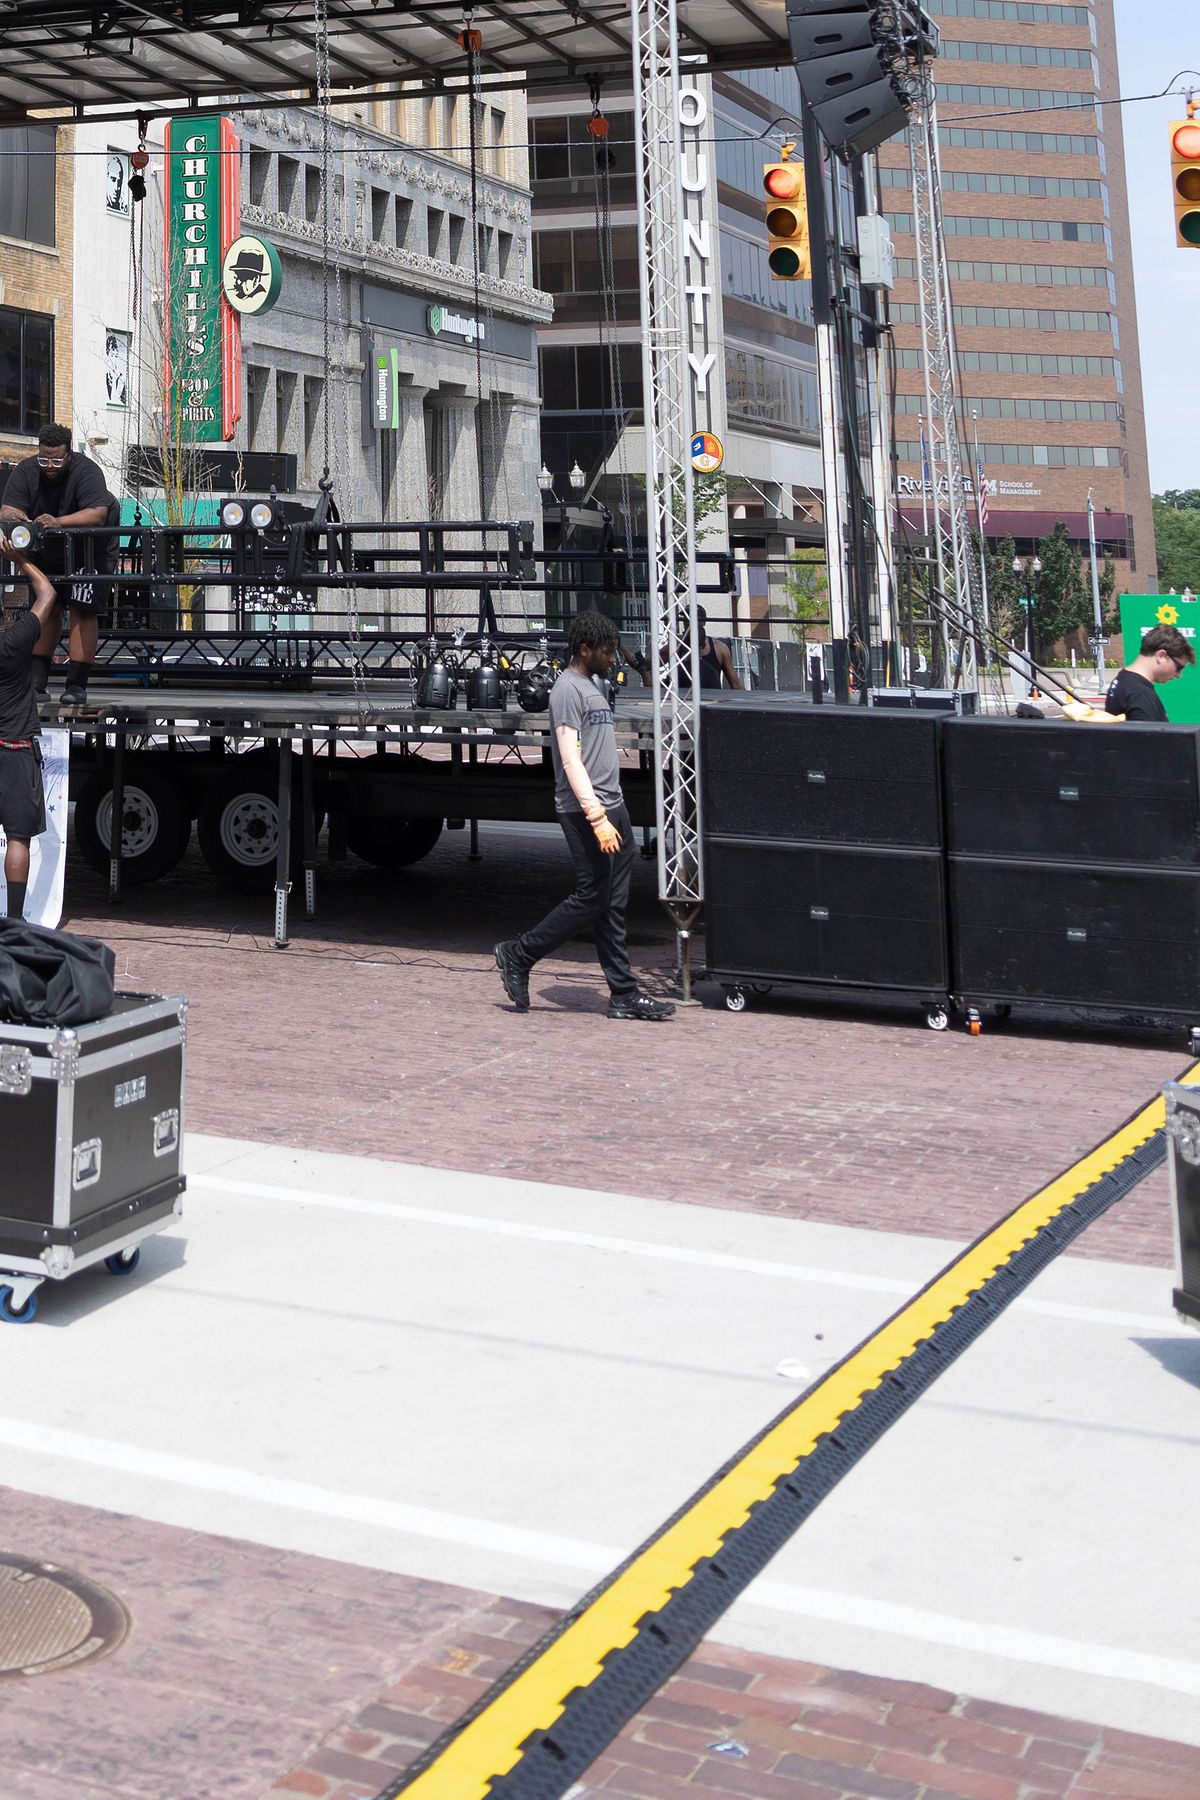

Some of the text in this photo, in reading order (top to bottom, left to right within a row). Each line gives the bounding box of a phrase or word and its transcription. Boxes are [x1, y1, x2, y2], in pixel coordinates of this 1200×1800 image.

[678, 55, 716, 392] OUNTY
[377, 368, 389, 421] Huntington
[181, 406, 215, 421] PIRITS
[999, 488, 1042, 496] MANAGEMENT
